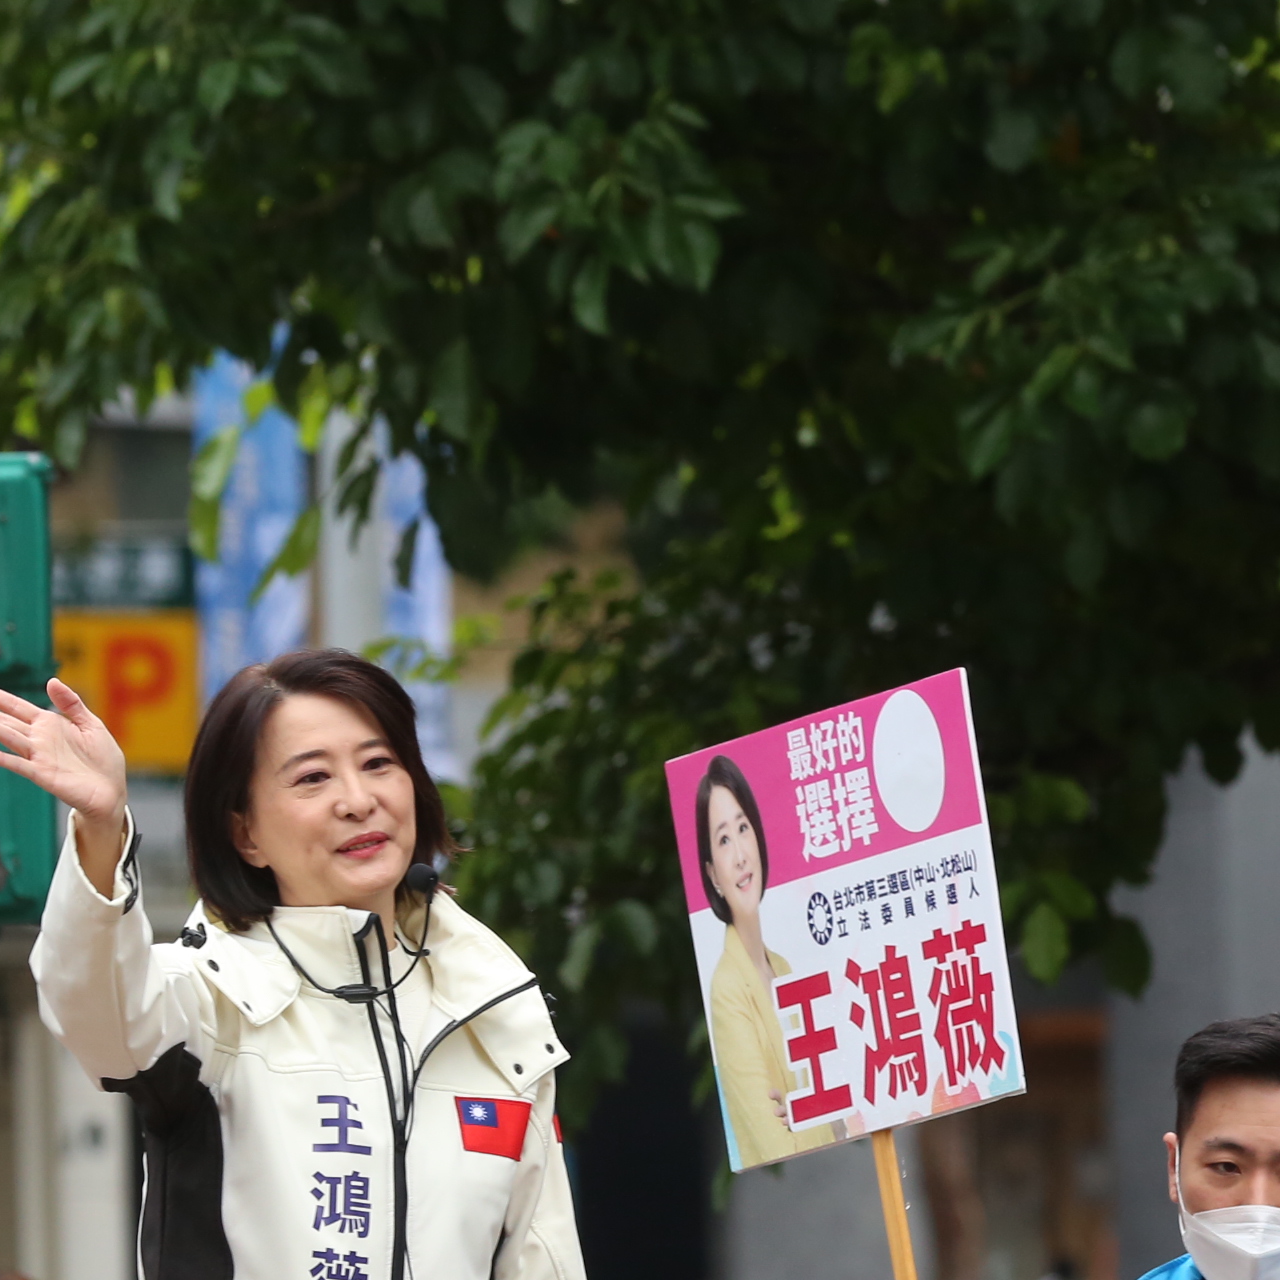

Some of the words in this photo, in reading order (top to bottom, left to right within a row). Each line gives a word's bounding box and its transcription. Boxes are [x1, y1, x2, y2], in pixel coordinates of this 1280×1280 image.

[785, 710, 866, 781] 最好的
[794, 765, 879, 863] 選擇
[836, 876, 980, 938] 立法委員候選人
[776, 918, 1006, 1124] 王鴻薇
